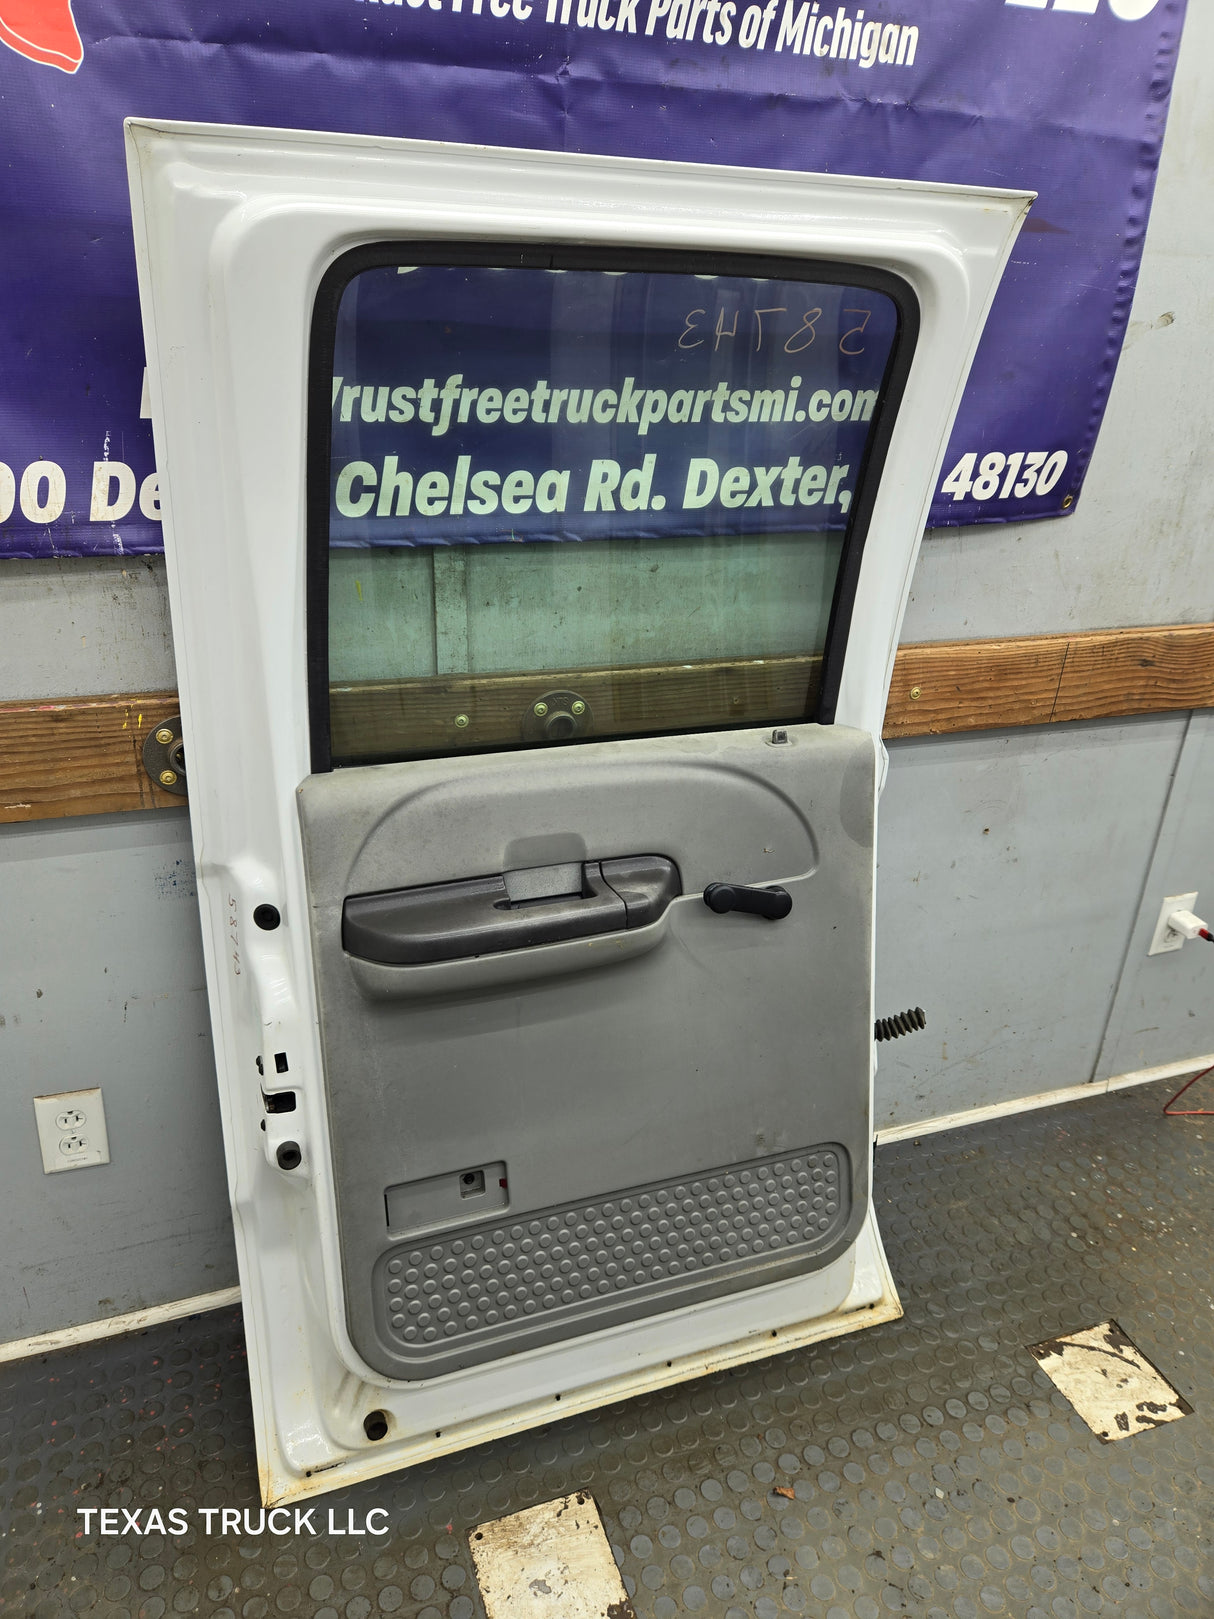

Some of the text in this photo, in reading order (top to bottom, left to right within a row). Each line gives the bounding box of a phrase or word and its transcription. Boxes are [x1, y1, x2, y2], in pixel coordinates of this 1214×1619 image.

[645, 0, 737, 45] Parts
[738, 0, 779, 50] of
[774, 0, 919, 68] Michigan
[335, 455, 571, 518] Chelsea
[583, 453, 667, 512] Rd.
[682, 456, 852, 514] Dexter,
[941, 450, 1069, 500] 48130
